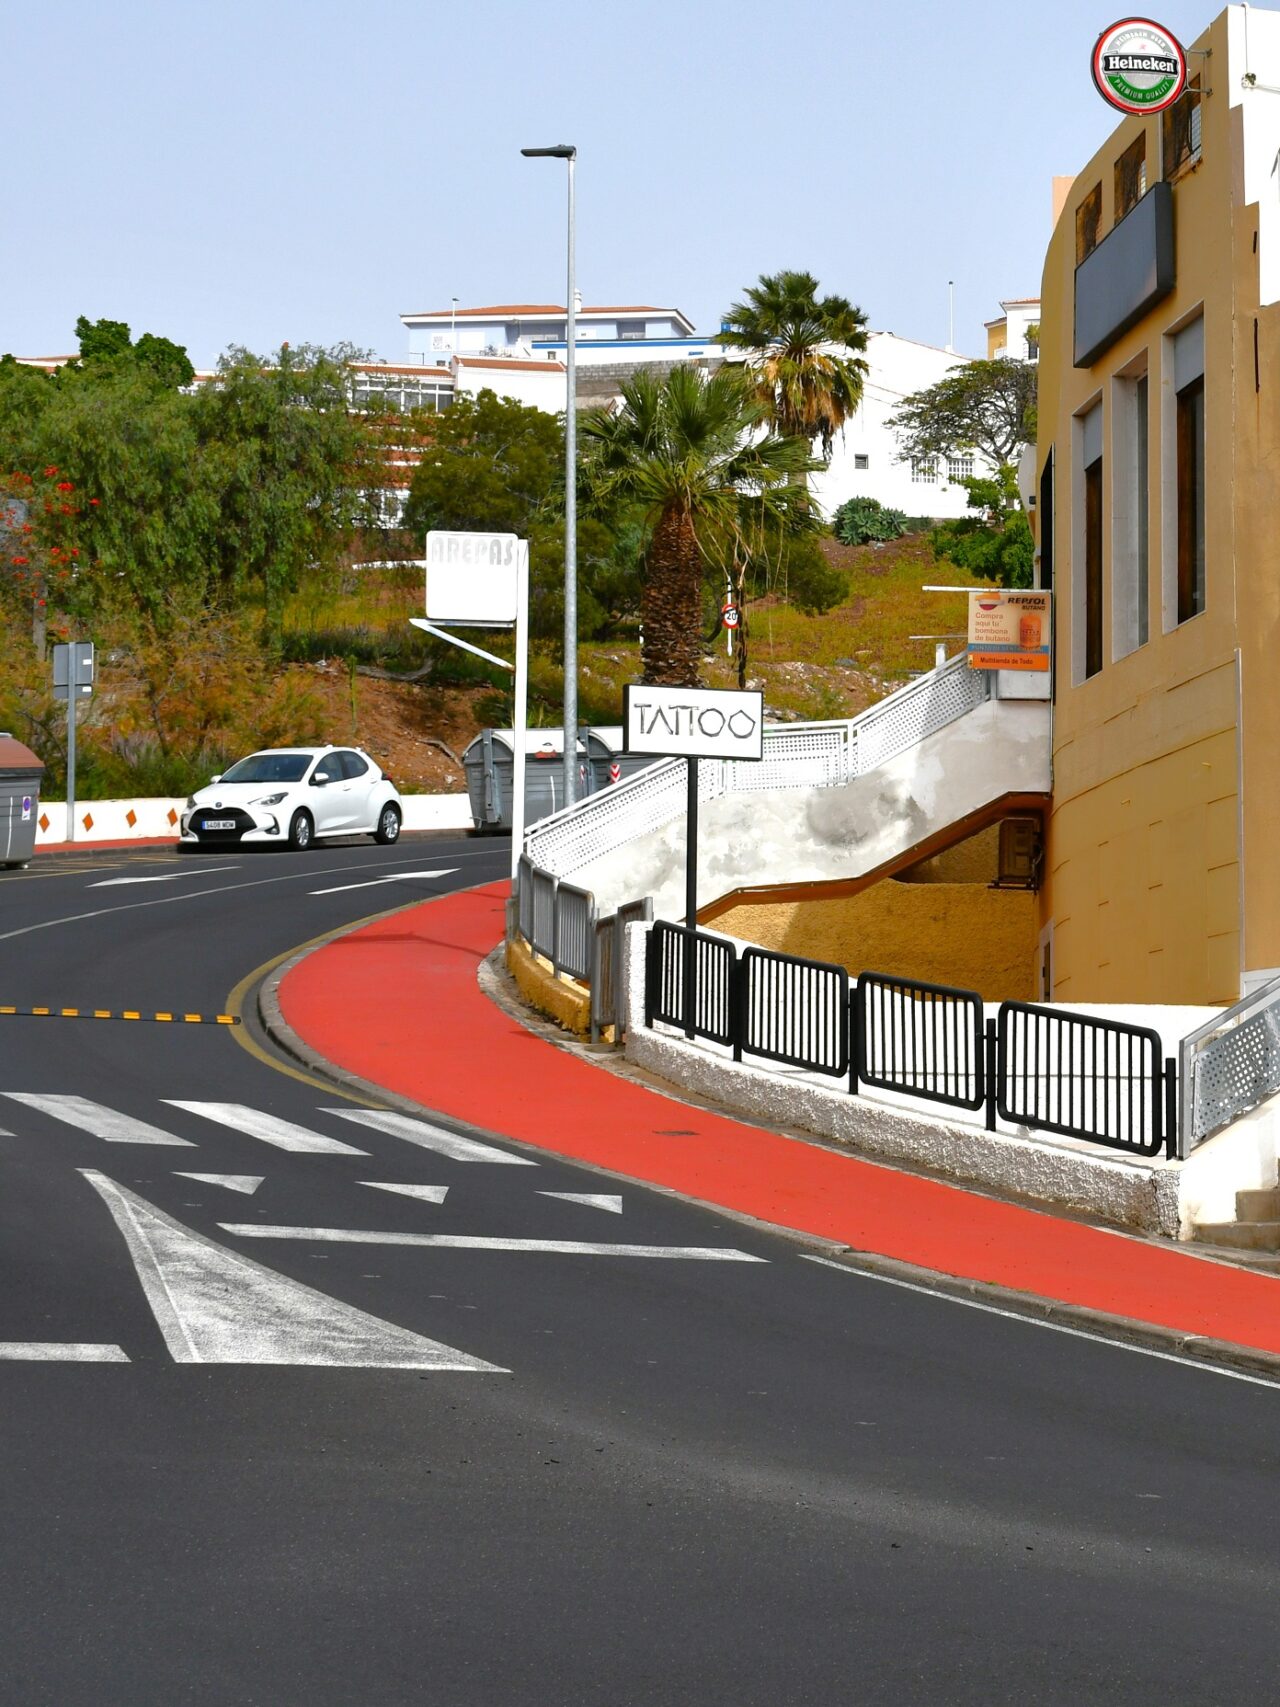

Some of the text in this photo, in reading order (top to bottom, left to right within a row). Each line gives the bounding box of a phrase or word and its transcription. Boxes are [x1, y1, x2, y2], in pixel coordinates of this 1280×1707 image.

[1108, 56, 1174, 72] Heineken
[1114, 79, 1170, 99] PREMIUM QUALITY
[432, 537, 513, 566] AREPAS
[727, 612, 736, 620] 20
[634, 703, 756, 738] TATTOO
